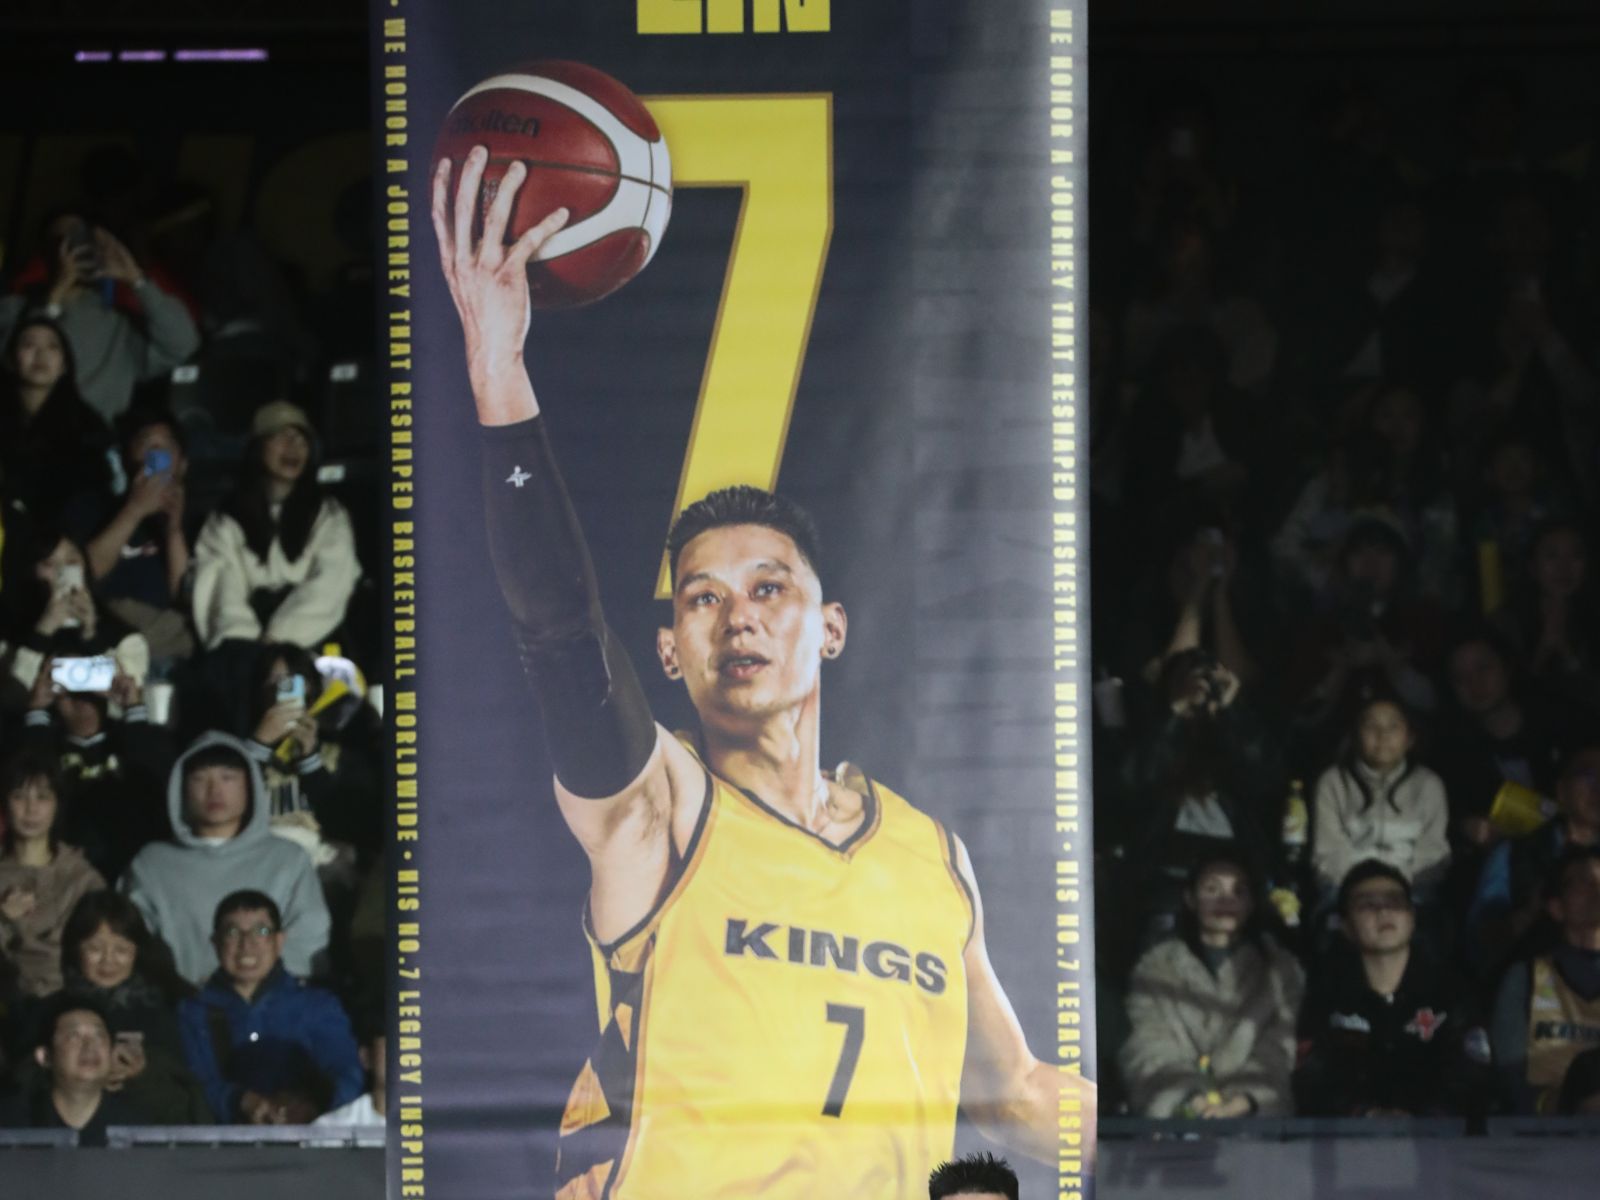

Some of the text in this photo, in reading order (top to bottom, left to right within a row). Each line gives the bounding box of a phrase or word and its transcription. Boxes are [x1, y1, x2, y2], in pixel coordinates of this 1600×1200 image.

[385, 20, 405, 51] WE
[1050, 11, 1072, 42] WE
[385, 66, 406, 146] HONOR
[1051, 57, 1072, 136] HONOR
[387, 159, 407, 172] A
[1051, 150, 1072, 162] A
[387, 186, 409, 297] JOURNEY
[1051, 176, 1072, 287] JOURNEY
[390, 311, 411, 368] THAT
[641, 92, 834, 600] 7
[1052, 303, 1074, 359] THAT
[390, 382, 413, 510] RESHAPED
[1052, 374, 1075, 499] RESHAPED
[392, 521, 416, 679] BASKETBALL
[1053, 513, 1076, 668] BASKETBALL
[395, 692, 417, 840] WORLDWIDE
[1055, 683, 1077, 831] WORLDWIDE
[397, 870, 419, 911] HIS
[1056, 860, 1079, 902] HIS
[723, 917, 949, 996] KINGS
[399, 991, 422, 1082] LEGACY
[820, 1002, 865, 1119] 7
[1057, 981, 1081, 1076] LEGACY
